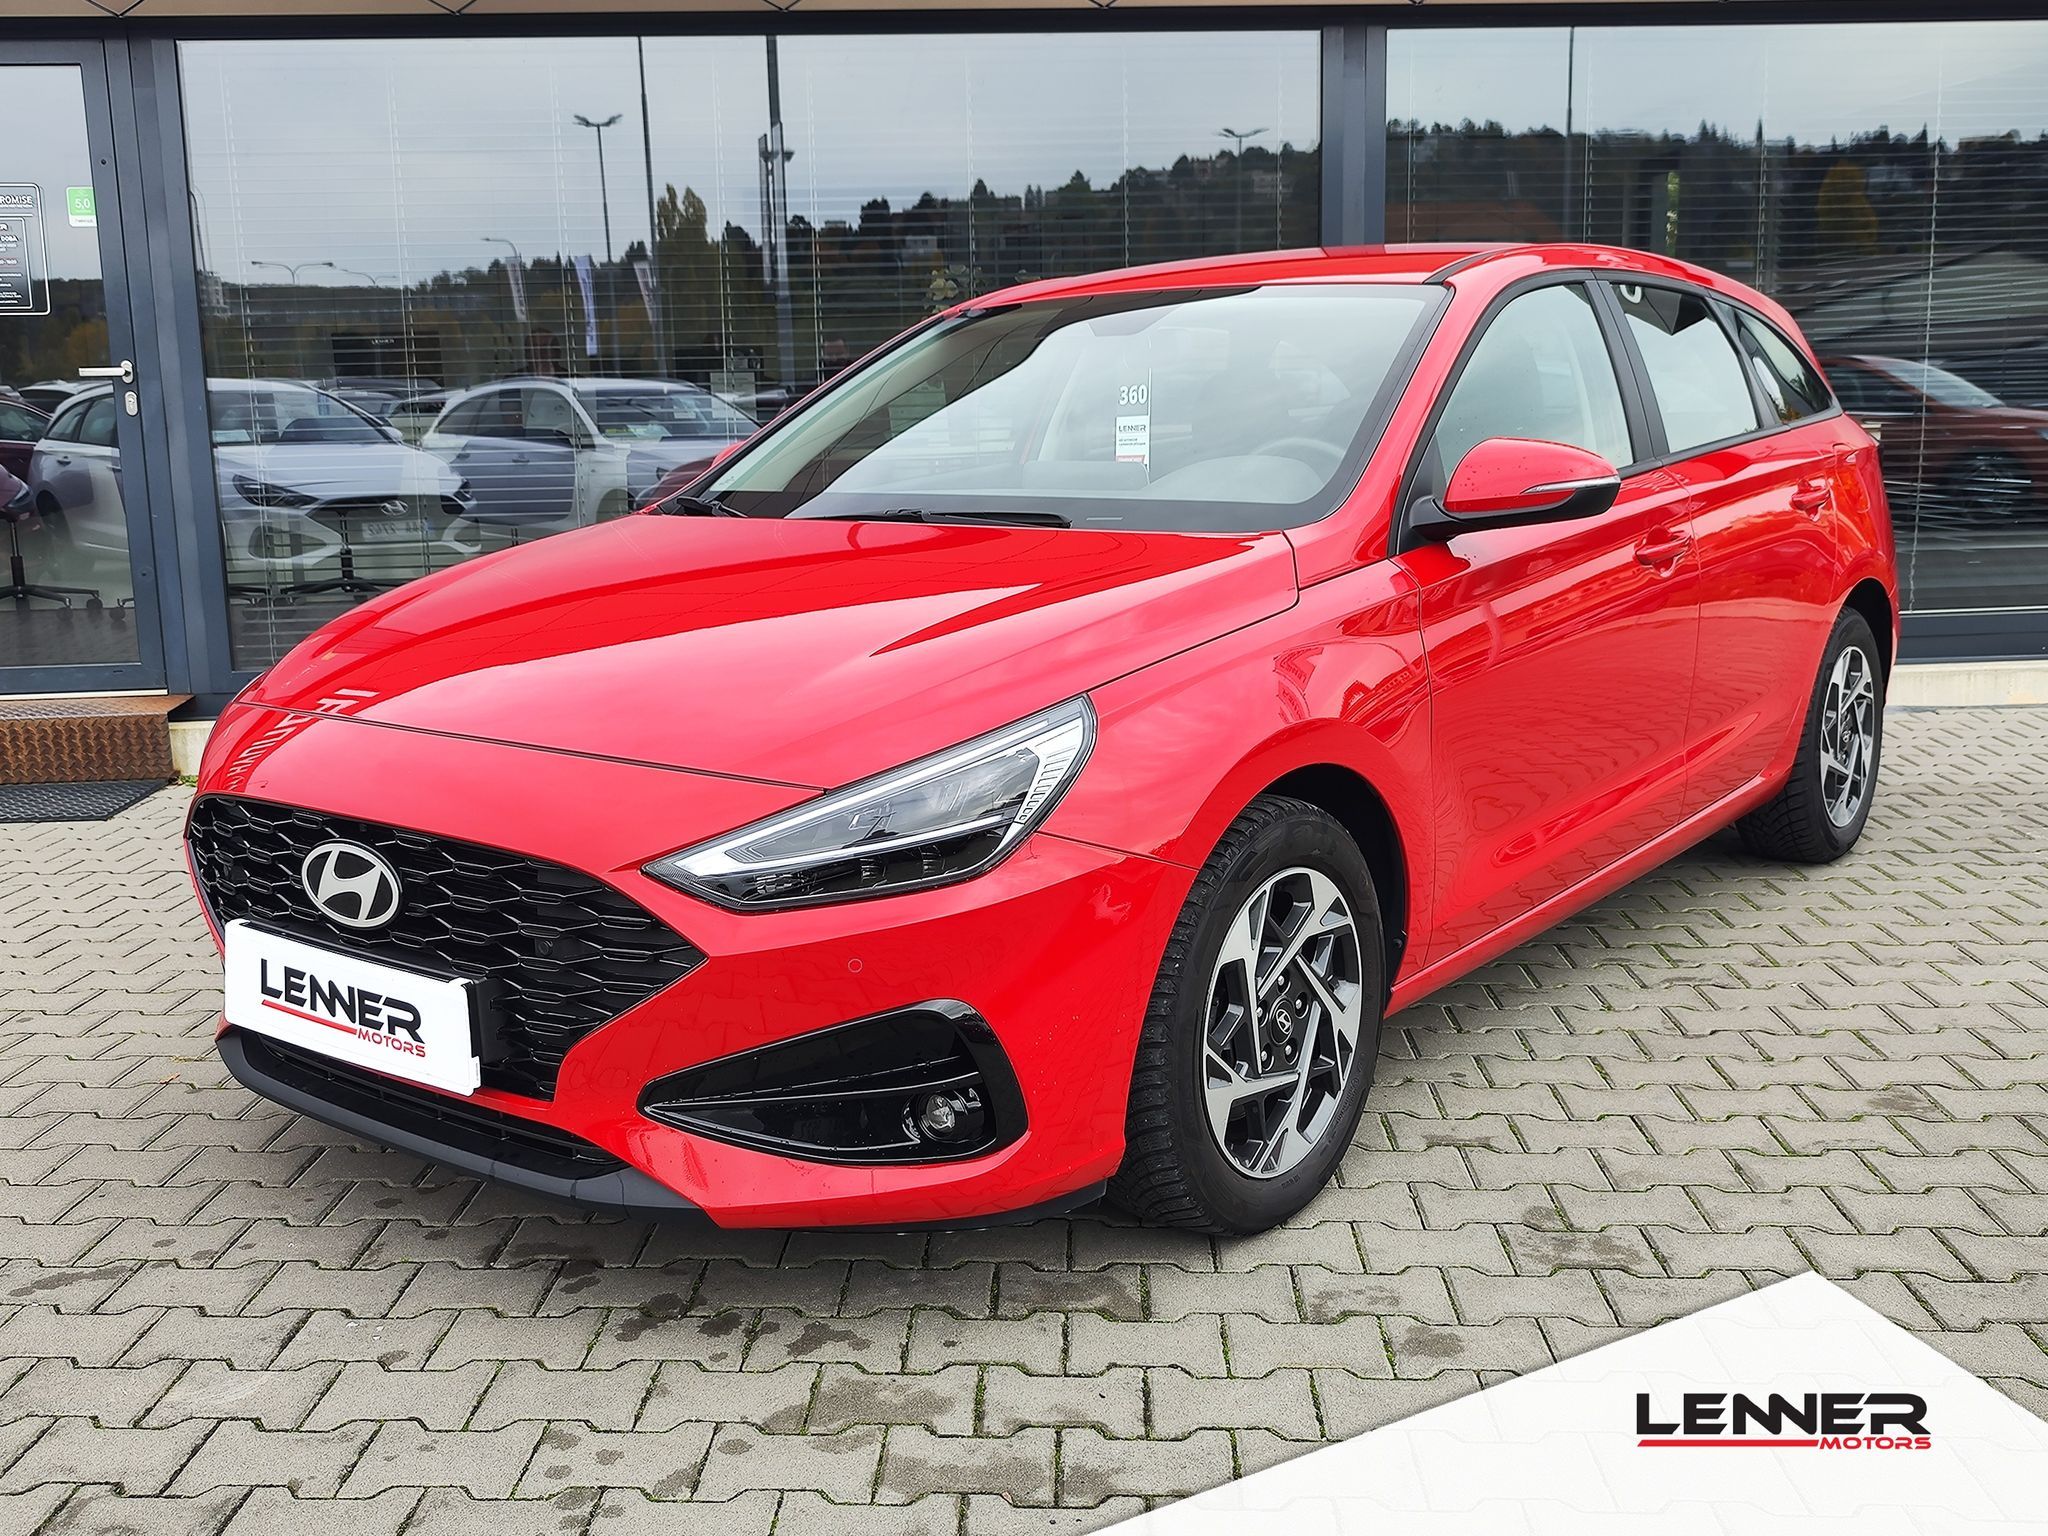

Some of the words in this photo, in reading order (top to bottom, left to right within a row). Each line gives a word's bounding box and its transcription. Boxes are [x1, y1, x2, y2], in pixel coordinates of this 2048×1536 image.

[1119, 384, 1148, 405] 360
[260, 958, 426, 1044] LENNER
[357, 1027, 427, 1058] MOTORS
